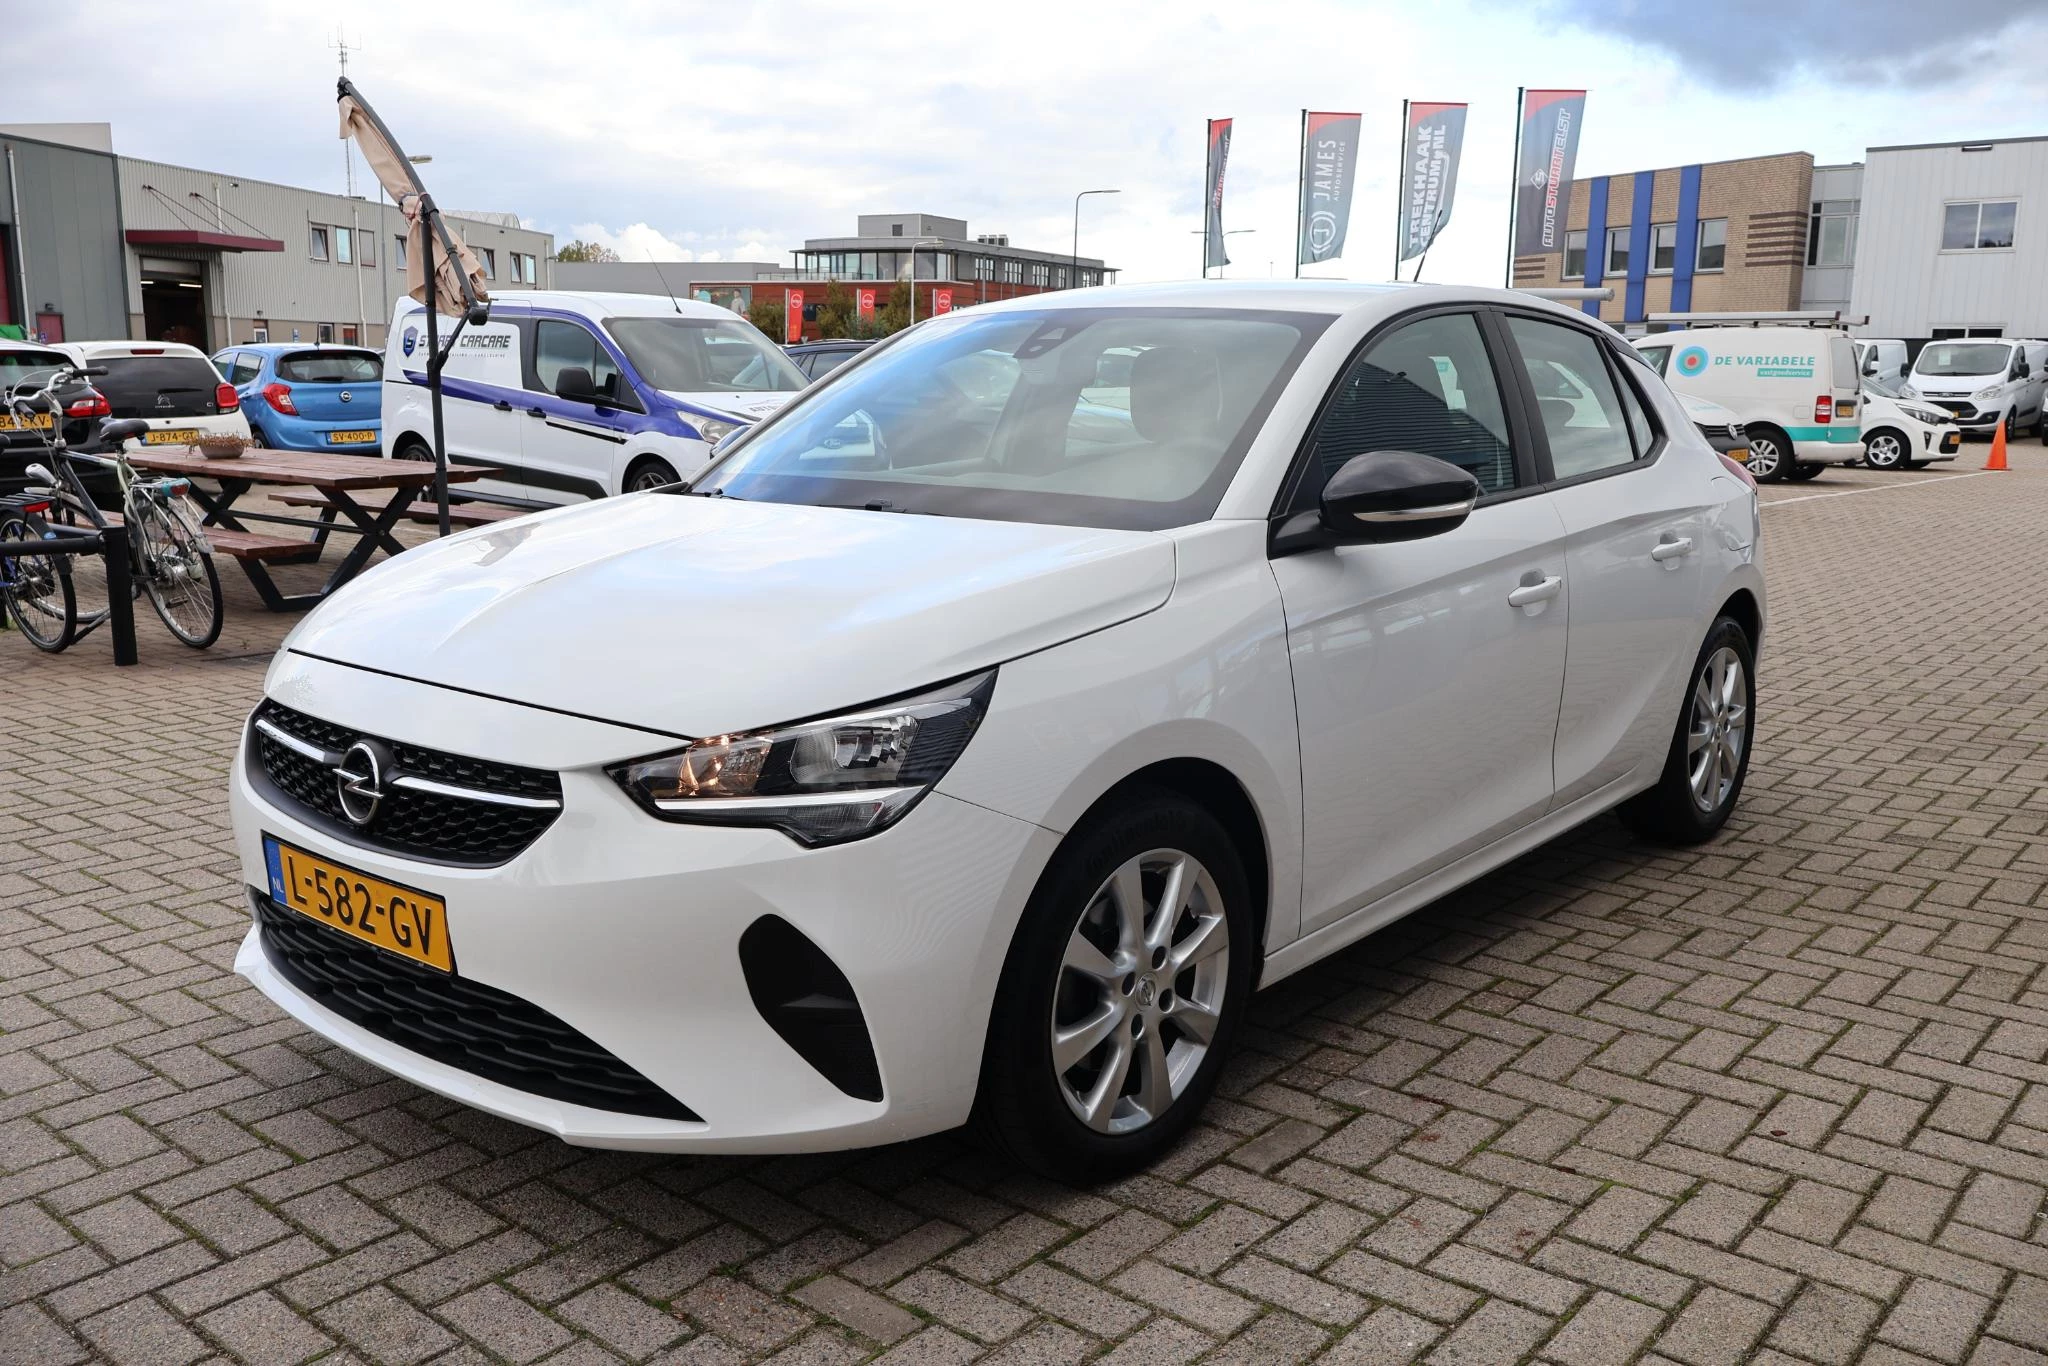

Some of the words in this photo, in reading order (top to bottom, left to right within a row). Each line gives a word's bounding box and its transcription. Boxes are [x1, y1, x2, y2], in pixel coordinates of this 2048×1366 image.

[1313, 140, 1336, 201] JAMES
[1409, 125, 1432, 249] TREKHAAK
[460, 335, 511, 348] CARCARE
[1714, 356, 1732, 365] DE
[1737, 356, 1815, 366] VARIABELE
[272, 876, 284, 894] NL
[288, 855, 432, 956] L-582-GV
